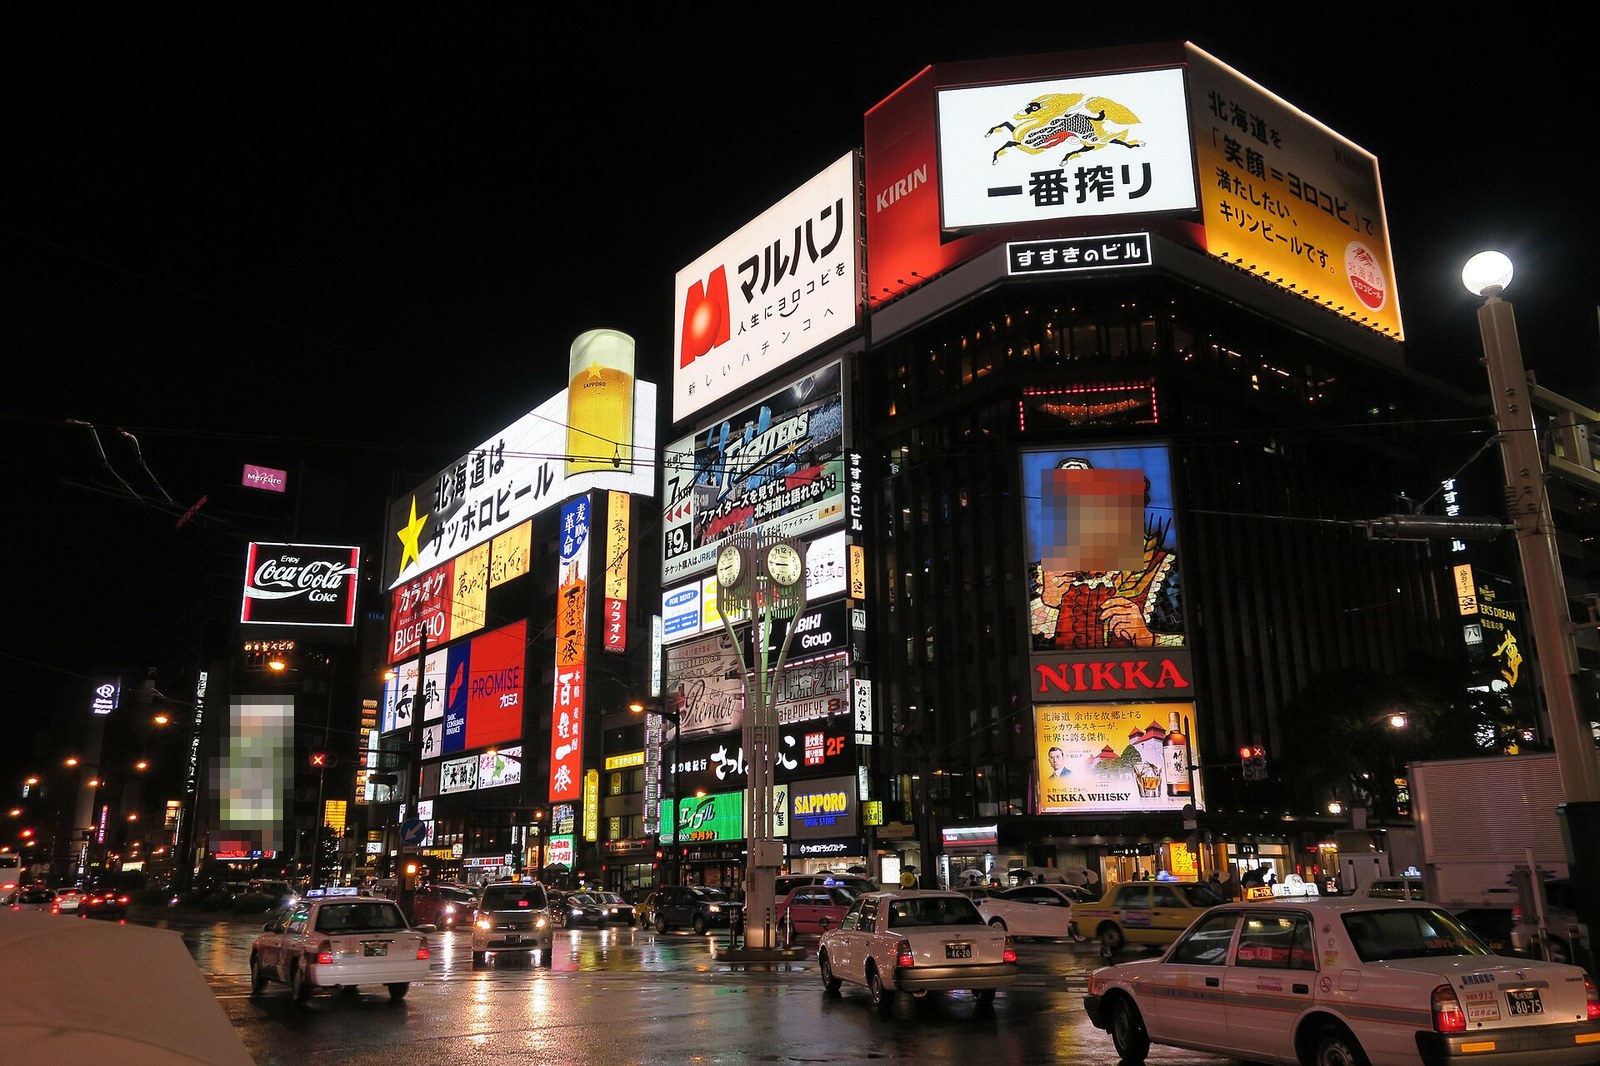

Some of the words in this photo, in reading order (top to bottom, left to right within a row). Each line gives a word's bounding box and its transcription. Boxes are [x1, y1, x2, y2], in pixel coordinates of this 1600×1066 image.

[1208, 89, 1281, 150] 北海道を
[875, 163, 928, 214] KIRIN
[986, 162, 1152, 208] 一番搾り
[1216, 166, 1297, 226] 満たしたい、
[737, 197, 844, 304] マルハン
[1220, 201, 1335, 274] キリンビールです。
[1017, 243, 1141, 267] すすきのビル
[737, 262, 845, 336] 人生にヨロコビを
[688, 308, 834, 396] 新しいパチンコへ
[582, 381, 607, 389] SAPPORO
[717, 411, 810, 501] FIGHTERS
[247, 472, 282, 485] Mercure
[433, 438, 506, 513] 北海道は
[431, 461, 554, 557] サッポロビール
[699, 478, 786, 525] ファイターズを見ずに
[563, 513, 575, 556] 革命
[673, 528, 684, 554] 9
[254, 559, 346, 589] Coca-Cola
[280, 555, 300, 564] Enjoy
[308, 589, 338, 602] Coke
[399, 572, 446, 614] カラオケ
[609, 600, 622, 644] カラオケ
[1493, 606, 1517, 622] DREAM
[394, 625, 414, 656] BIG
[801, 631, 832, 649] Group
[472, 665, 520, 701] PROMISE
[1035, 658, 1190, 693] NIKKA
[500, 692, 518, 709] プロミス
[793, 700, 825, 718] POPEYE
[446, 718, 465, 729] CONSUMER
[446, 726, 461, 736] FINANCE
[1042, 712, 1071, 722] 北海道
[1074, 710, 1142, 721] 余市を故郷とする
[826, 736, 845, 756] 2F
[1043, 732, 1111, 743] 世界に誇る傑作。
[587, 785, 597, 840] すすきの交番
[794, 792, 847, 814] SAPPORO
[1047, 793, 1086, 803] NIKKA
[1085, 792, 1131, 802] WHISKY
[819, 816, 836, 826] STORE
[1478, 991, 1494, 1000] 913
